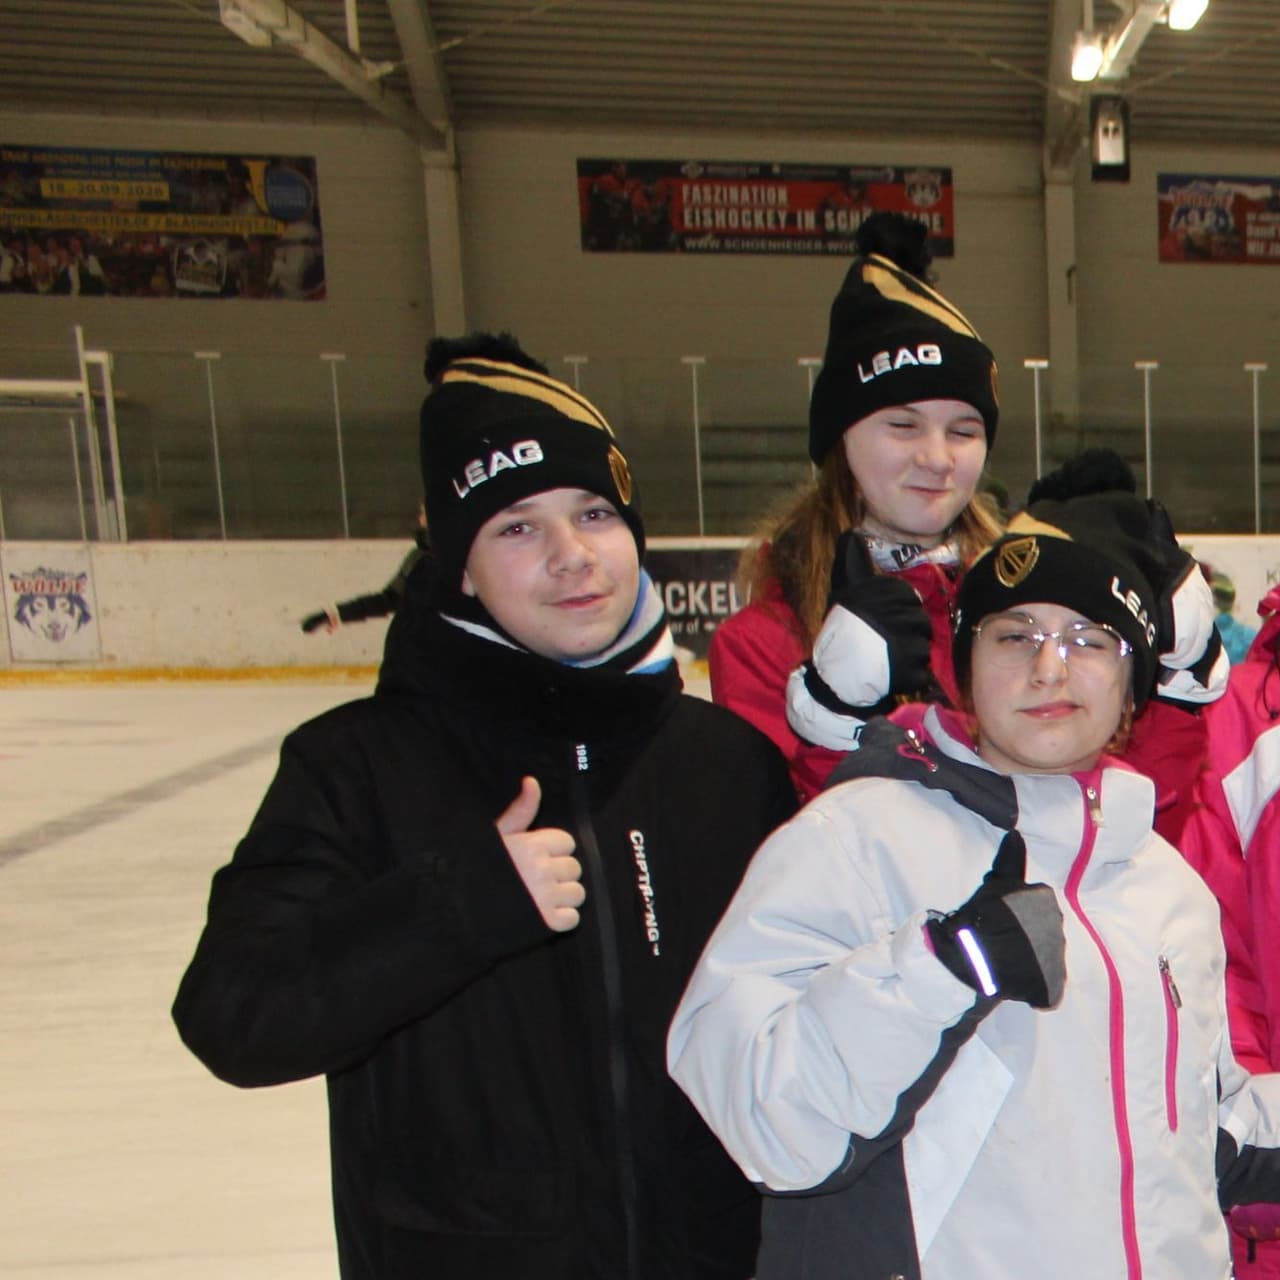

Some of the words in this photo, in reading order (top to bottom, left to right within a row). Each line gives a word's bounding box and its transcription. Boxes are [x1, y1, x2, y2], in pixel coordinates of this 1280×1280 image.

[681, 184, 788, 204] FASZINATION
[684, 209, 786, 231] EISHOCKEY
[797, 211, 816, 230] IN
[857, 344, 943, 383] LEAG
[452, 438, 545, 499] LEAG
[1111, 575, 1156, 646] LEAG
